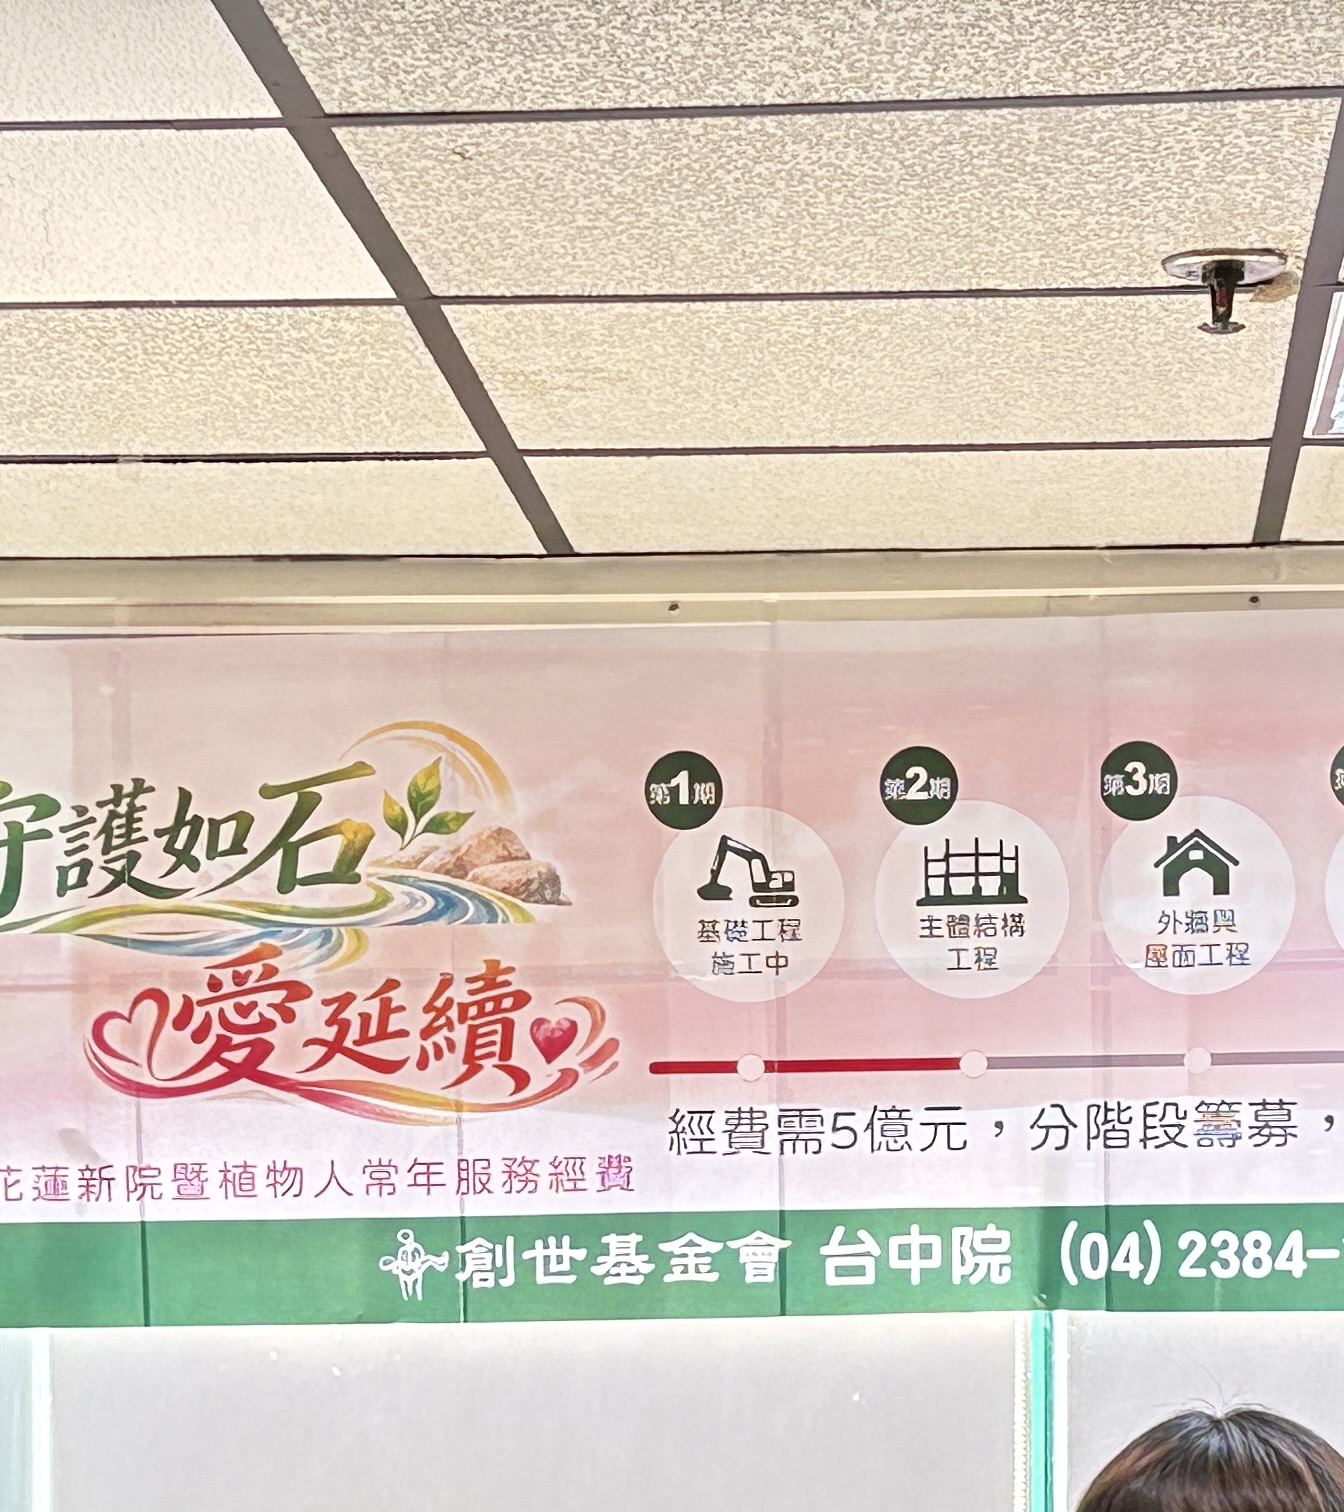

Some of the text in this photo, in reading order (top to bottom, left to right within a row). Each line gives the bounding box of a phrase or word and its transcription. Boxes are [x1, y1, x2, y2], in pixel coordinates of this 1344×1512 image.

[649, 770, 716, 806] 第1期
[883, 765, 952, 801] 第2期
[1103, 761, 1172, 796] 第3期
[697, 917, 803, 944] 基礎工程
[919, 912, 1026, 940] 主體結構
[711, 950, 789, 976] 施工中
[946, 945, 1000, 971] 工程
[1144, 941, 1252, 969] 屋面工程
[170, 940, 534, 1097] 愛延續
[455, 1229, 792, 1289] 創世基金會
[819, 1224, 1012, 1286] 台中院
[1060, 1219, 1162, 1288] (04)
